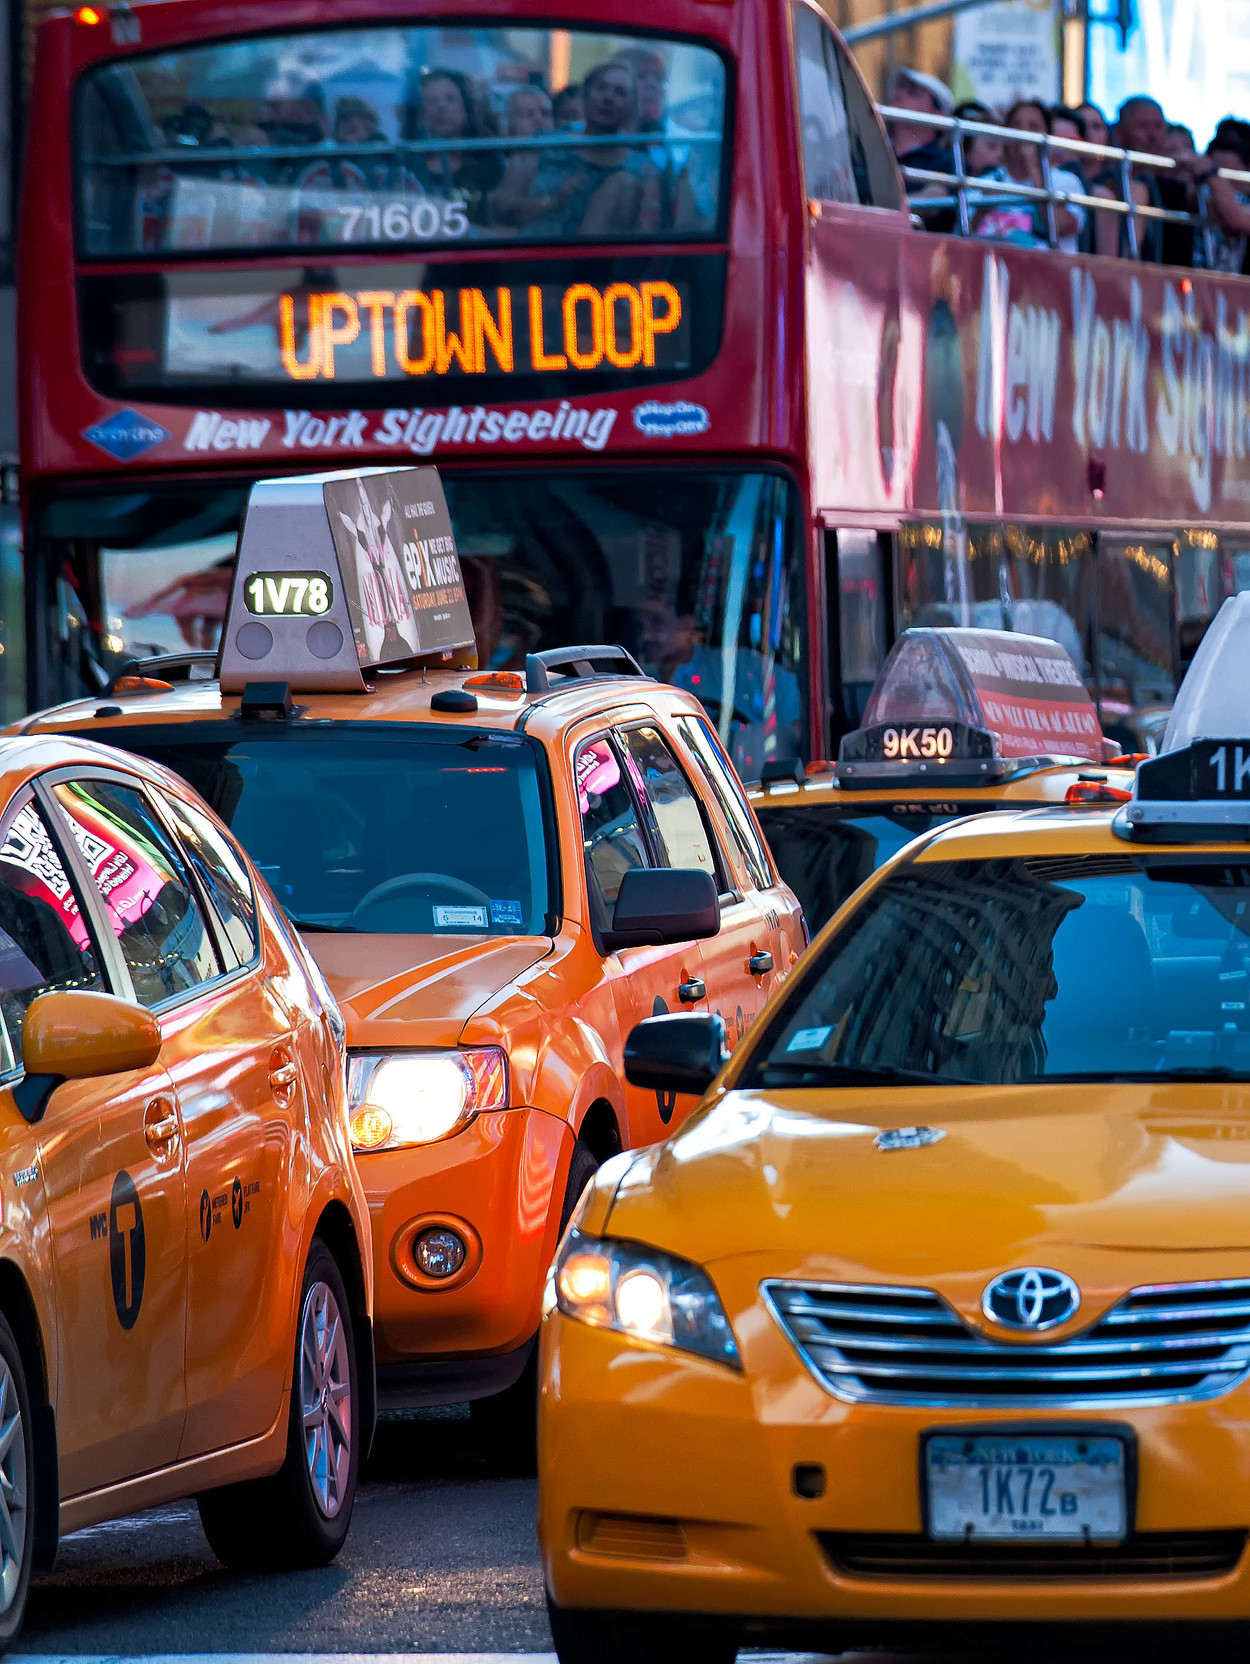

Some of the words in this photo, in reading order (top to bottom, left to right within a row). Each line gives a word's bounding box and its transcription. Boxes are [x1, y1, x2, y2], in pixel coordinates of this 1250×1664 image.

[338, 201, 470, 241] 71605
[279, 290, 513, 380] UPTOWN
[529, 280, 682, 372] LOOP
[975, 252, 1061, 443] New
[1071, 266, 1150, 454] York
[184, 411, 272, 451] New
[281, 409, 369, 448] York
[373, 400, 618, 456] Sightseeing
[403, 528, 437, 590] epix
[432, 555, 460, 585] MUSIC
[247, 577, 329, 615] 1V78
[884, 727, 953, 758] 9K50
[89, 1212, 108, 1241] NYC
